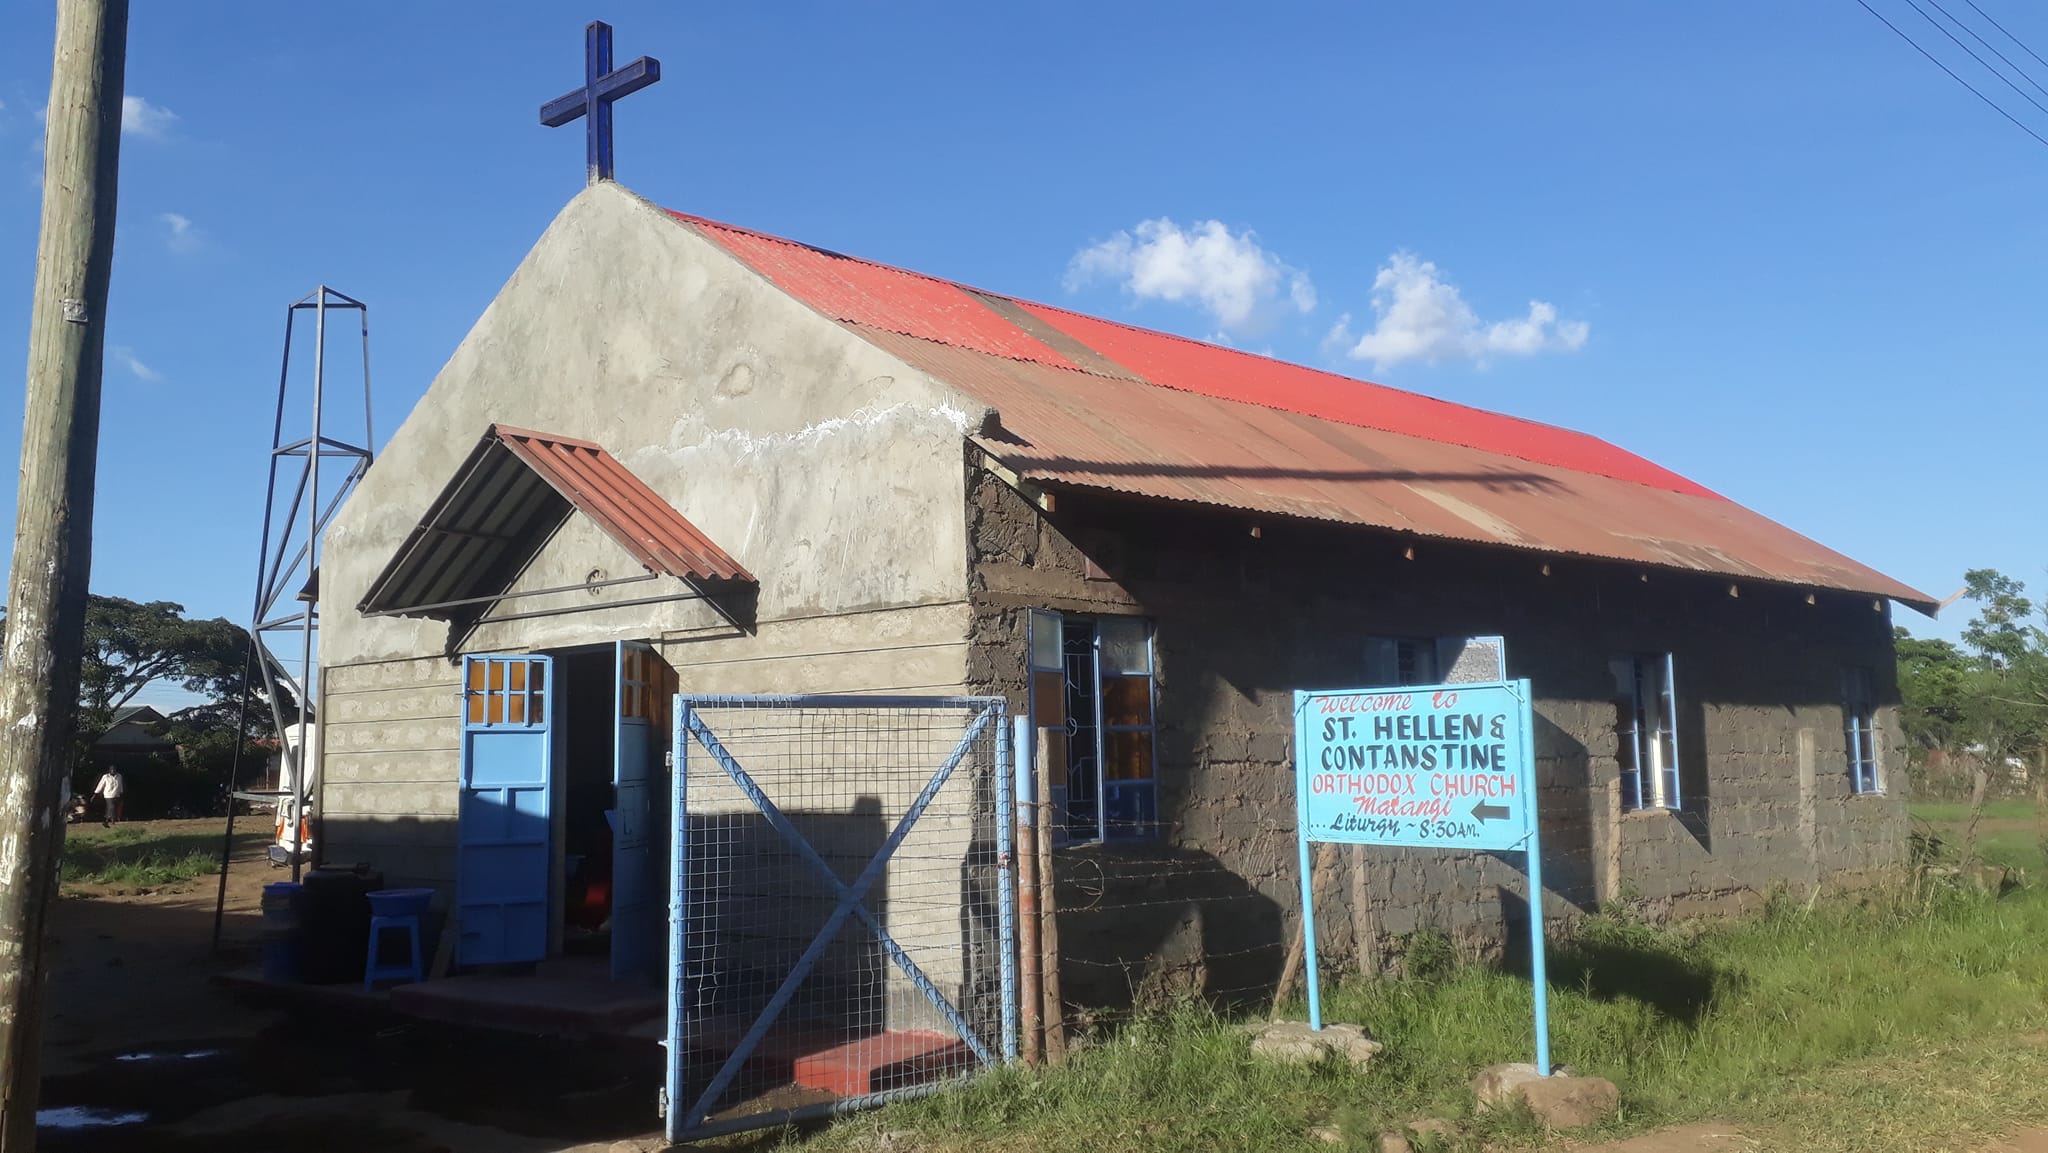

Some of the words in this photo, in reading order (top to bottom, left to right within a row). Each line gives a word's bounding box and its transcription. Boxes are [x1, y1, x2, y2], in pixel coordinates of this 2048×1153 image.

[1316, 694, 1412, 714] Welcome
[1432, 691, 1457, 709] to
[1322, 717, 1357, 742] ST.
[1374, 714, 1483, 740] HELLEN
[1490, 714, 1506, 740] &
[1321, 744, 1506, 771] CONTANSTINE
[1313, 773, 1417, 796] ORTHODOX
[1431, 773, 1515, 797] CHURCH
